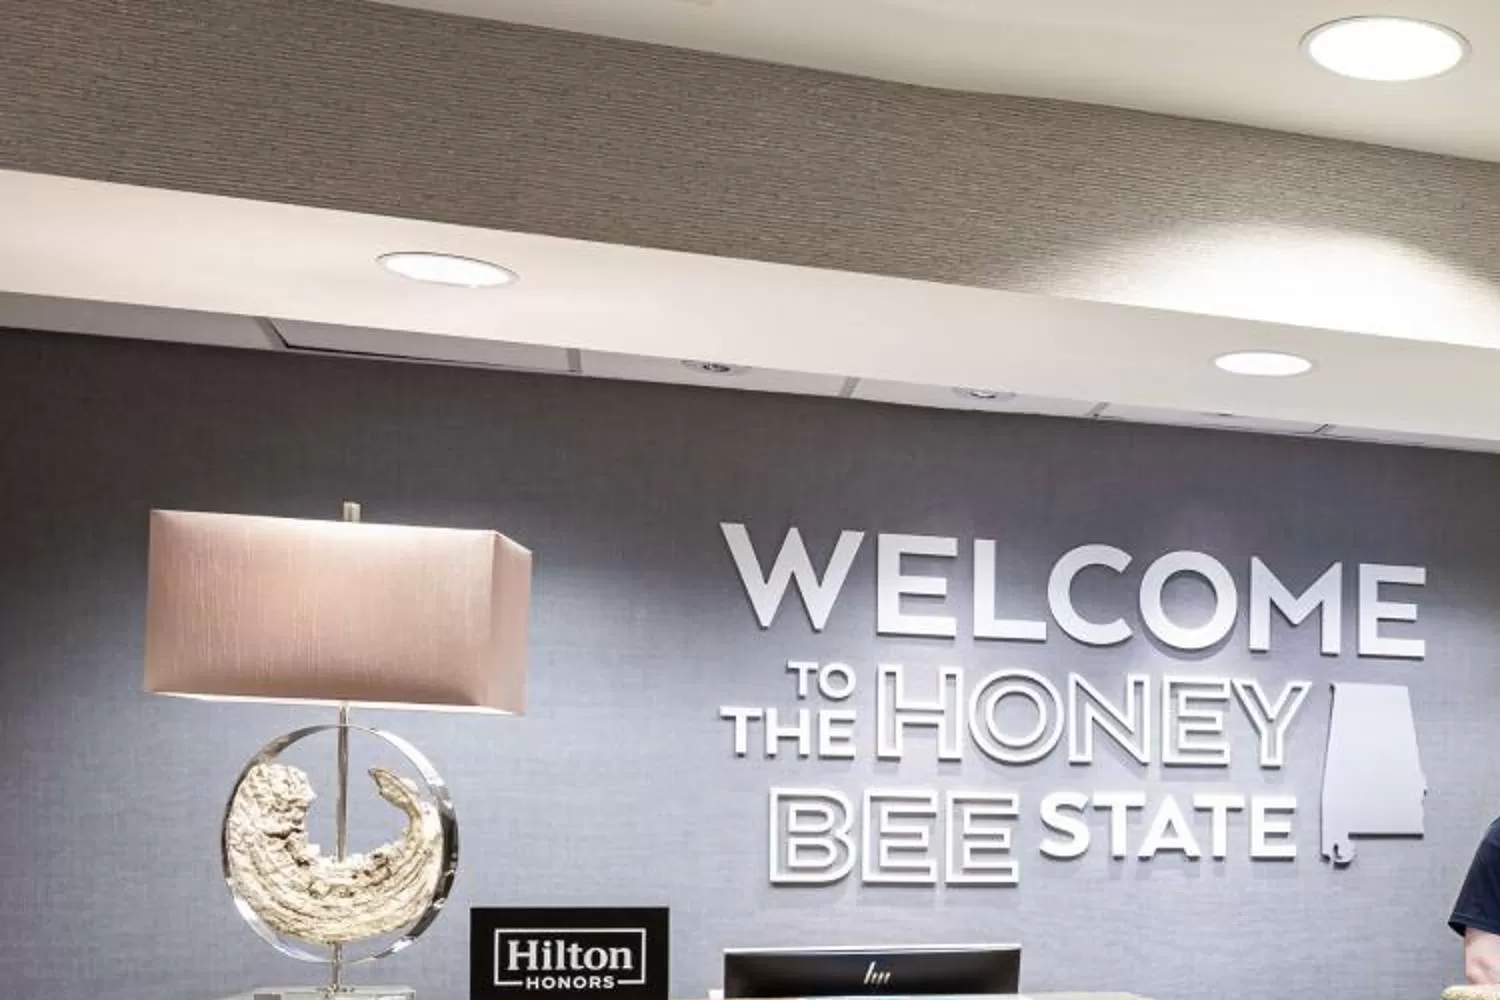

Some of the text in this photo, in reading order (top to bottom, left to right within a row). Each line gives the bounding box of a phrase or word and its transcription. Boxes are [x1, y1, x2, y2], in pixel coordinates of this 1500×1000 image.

[720, 523, 1426, 658] WELCOME
[787, 661, 857, 700] TO
[720, 664, 1312, 769] THE HONEY
[770, 787, 1297, 887] BEE STATE
[507, 940, 633, 971] Hilton
[525, 975, 615, 990] HONORS
